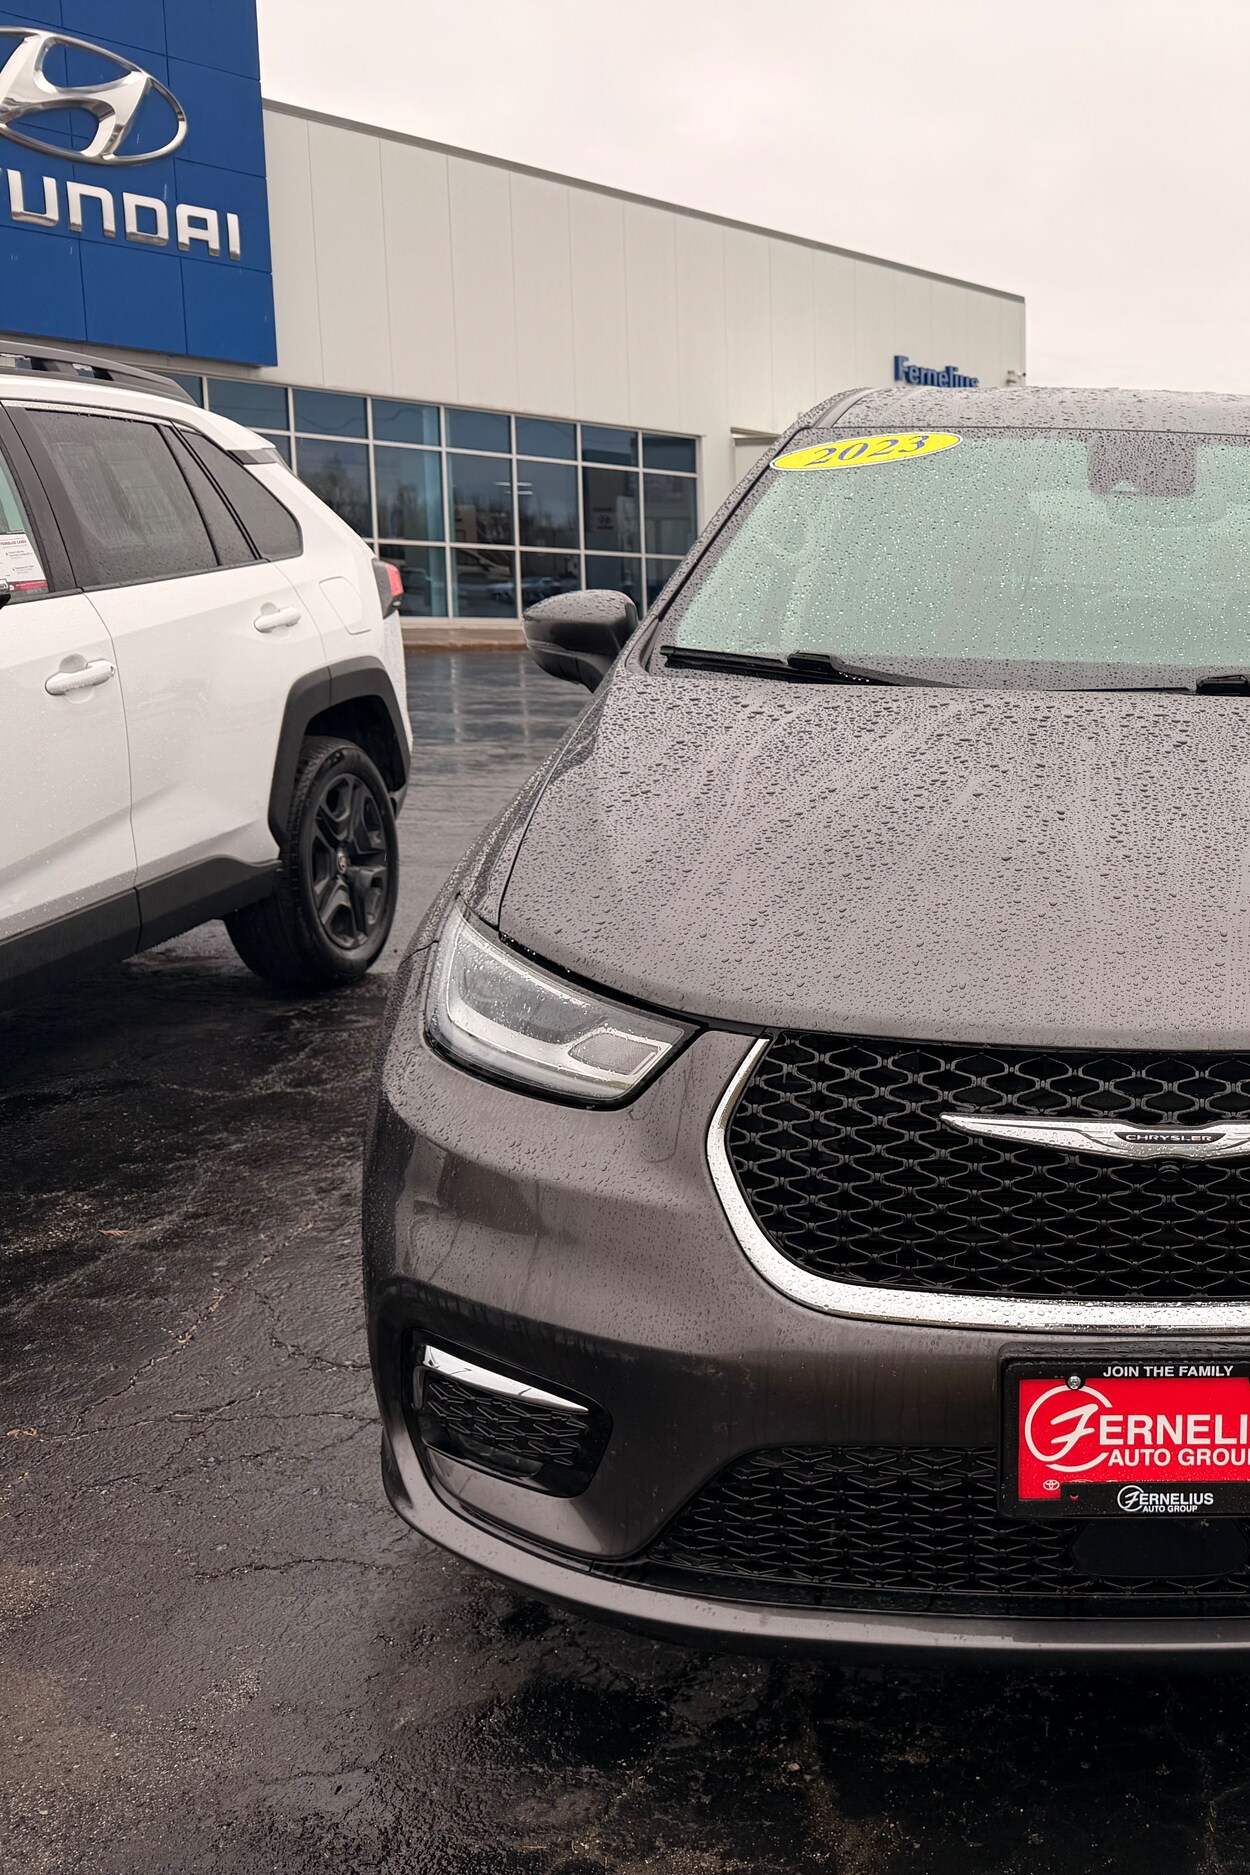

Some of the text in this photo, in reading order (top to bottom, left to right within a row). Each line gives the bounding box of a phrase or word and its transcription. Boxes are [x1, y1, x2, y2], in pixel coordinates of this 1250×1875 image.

[0, 167, 241, 261] UNDAI
[803, 434, 930, 467] 2023
[1102, 1365, 1234, 1378] JOIN THE FAMILY
[1107, 1448, 1171, 1467] AUTO
[1142, 1504, 1198, 1513] AUTO GROUP
